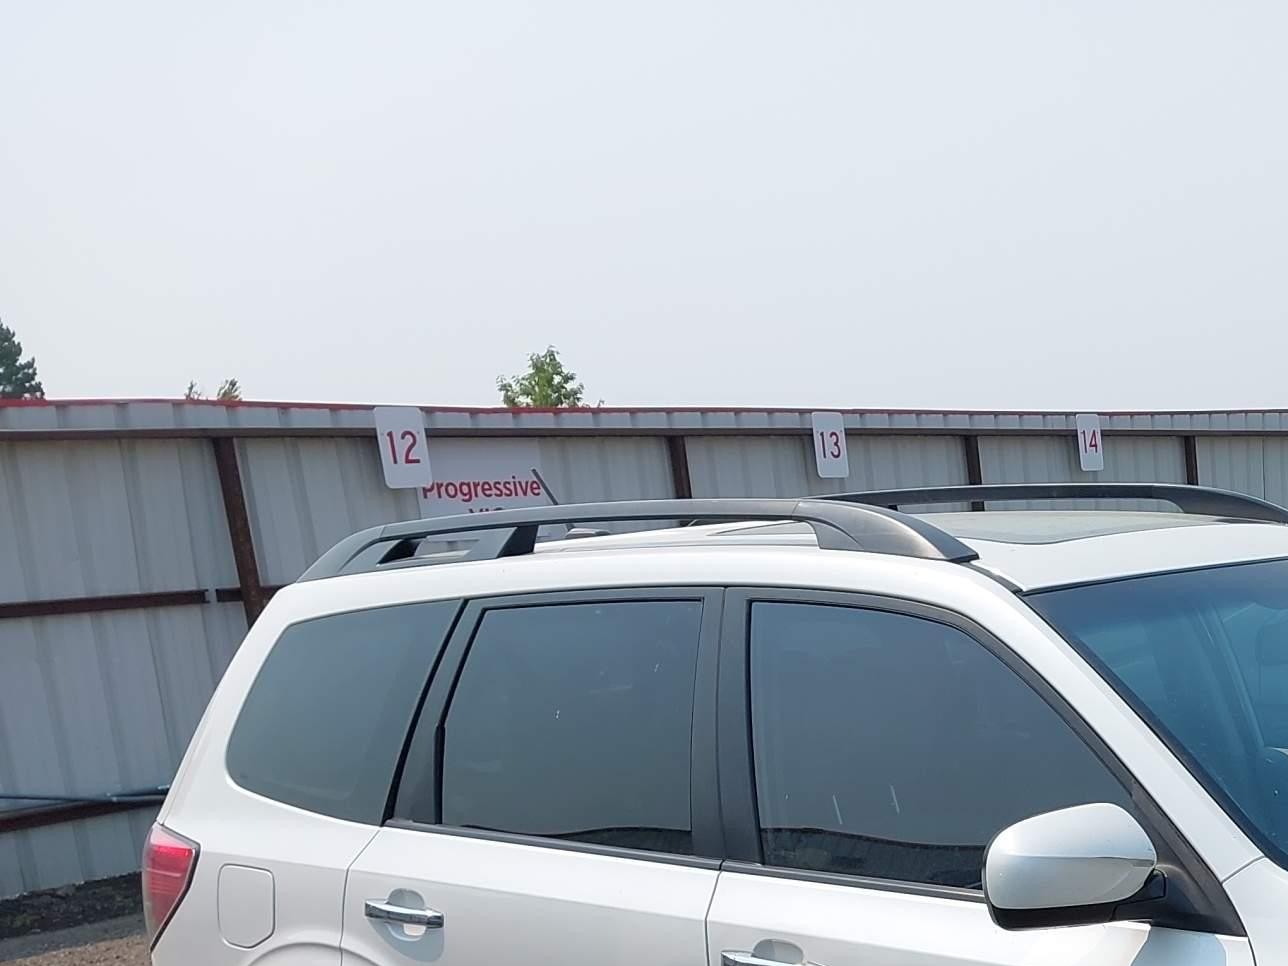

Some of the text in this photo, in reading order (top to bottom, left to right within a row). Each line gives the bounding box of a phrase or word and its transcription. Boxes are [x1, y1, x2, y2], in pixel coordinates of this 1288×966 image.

[386, 430, 421, 465] 12
[817, 431, 842, 459] 13
[1080, 429, 1099, 454] 14
[423, 475, 542, 503] Progressive
